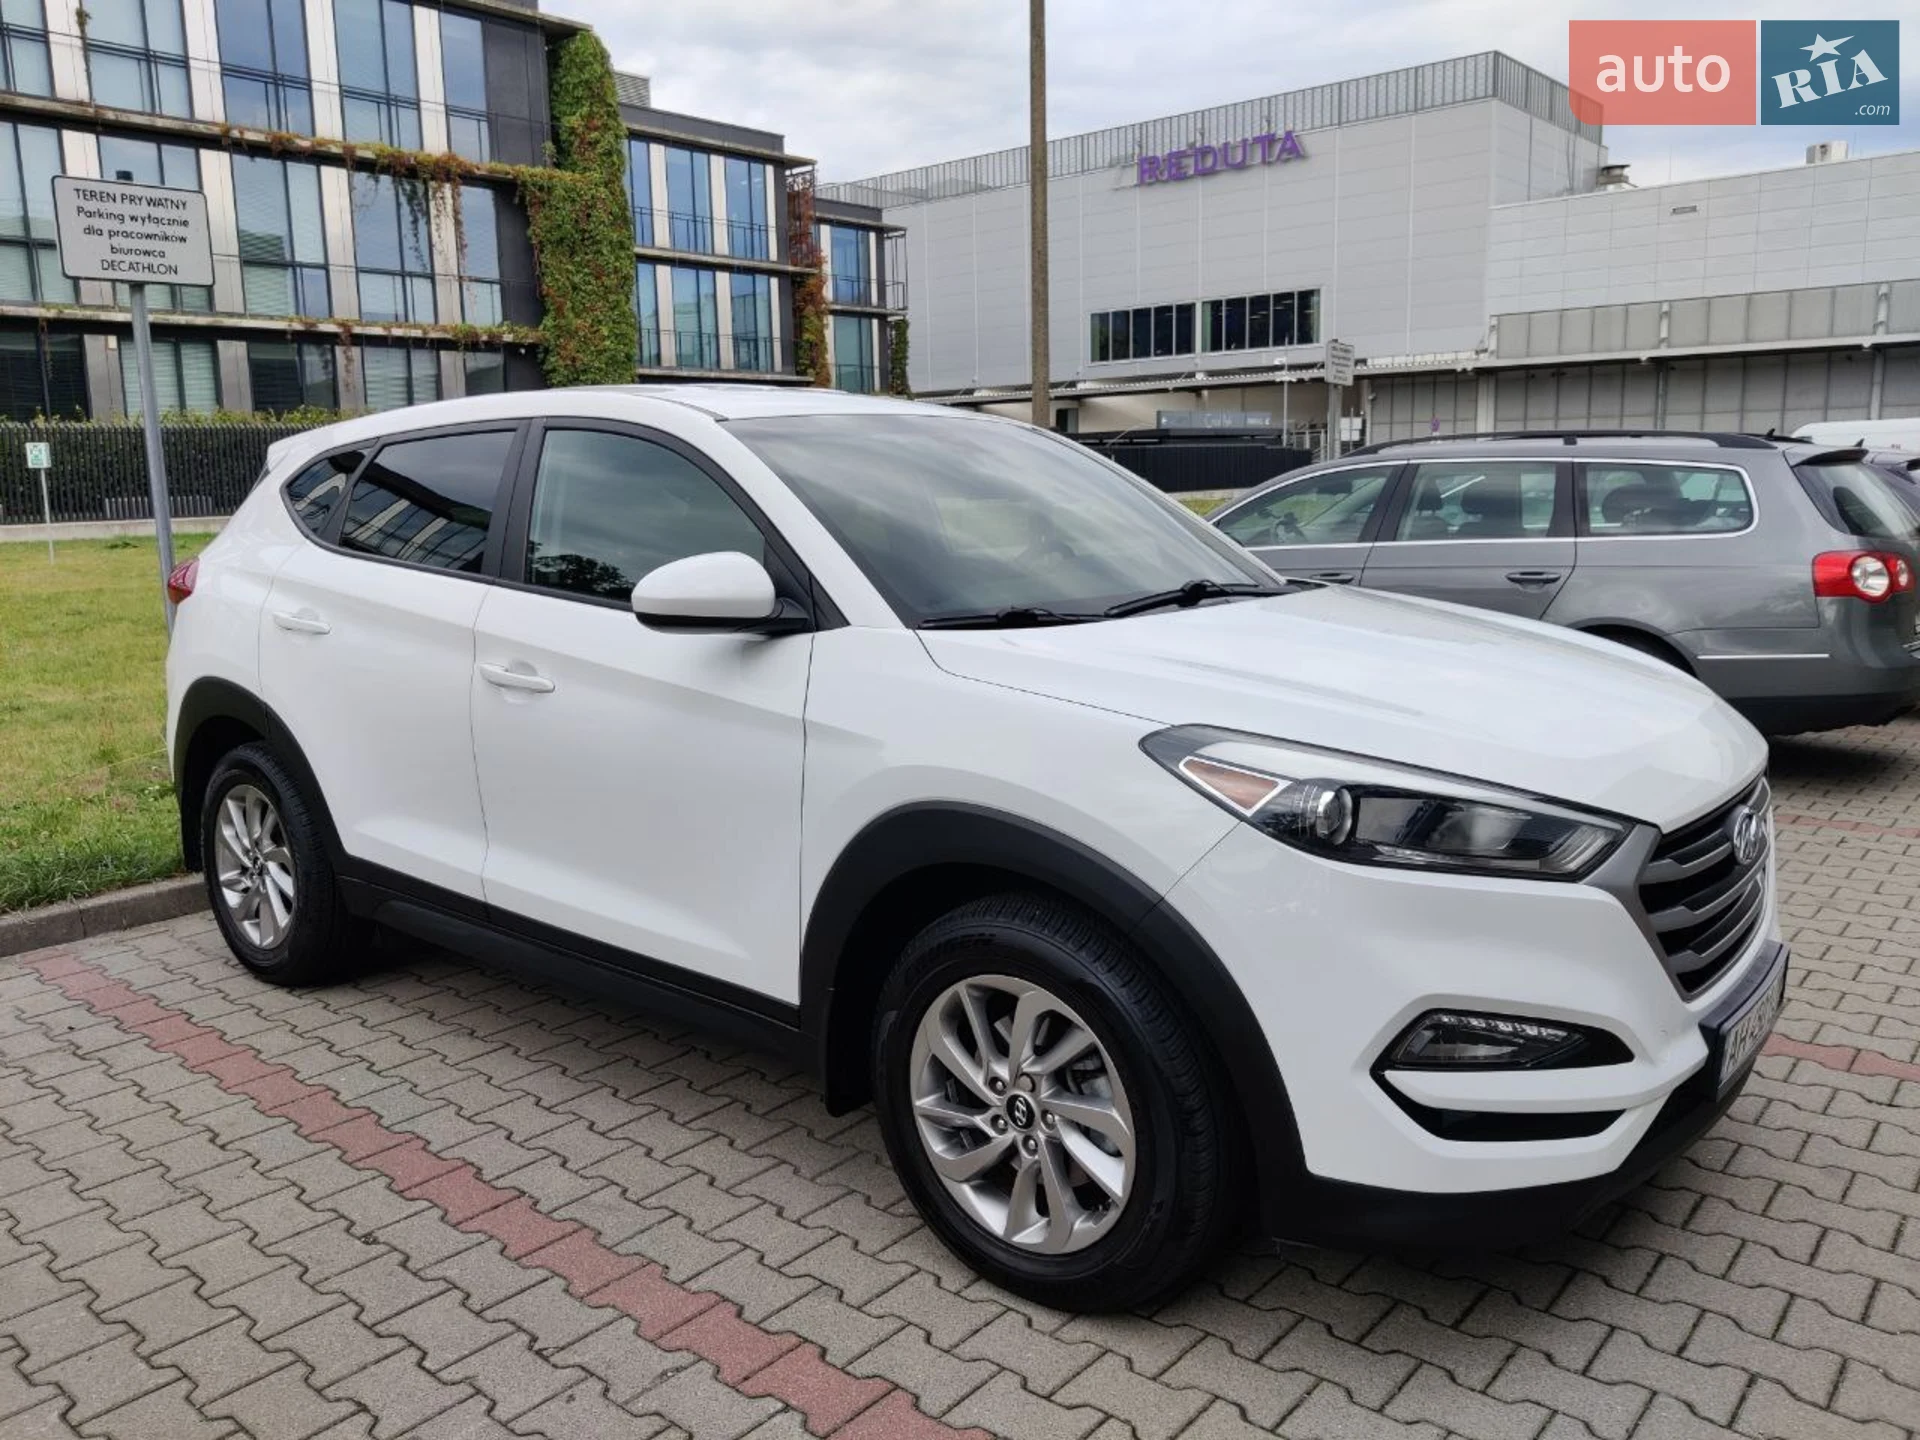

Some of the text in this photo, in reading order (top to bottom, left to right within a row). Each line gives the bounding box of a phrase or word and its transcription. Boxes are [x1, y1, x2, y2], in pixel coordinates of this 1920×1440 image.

[1138, 130, 1306, 186] REDUTA
[73, 188, 188, 211] TEREN PRYWATNY
[76, 206, 190, 228] Parking wyłącznie
[83, 224, 104, 236] dla
[110, 244, 166, 258] biurowca
[101, 259, 179, 276] DECATHLON
